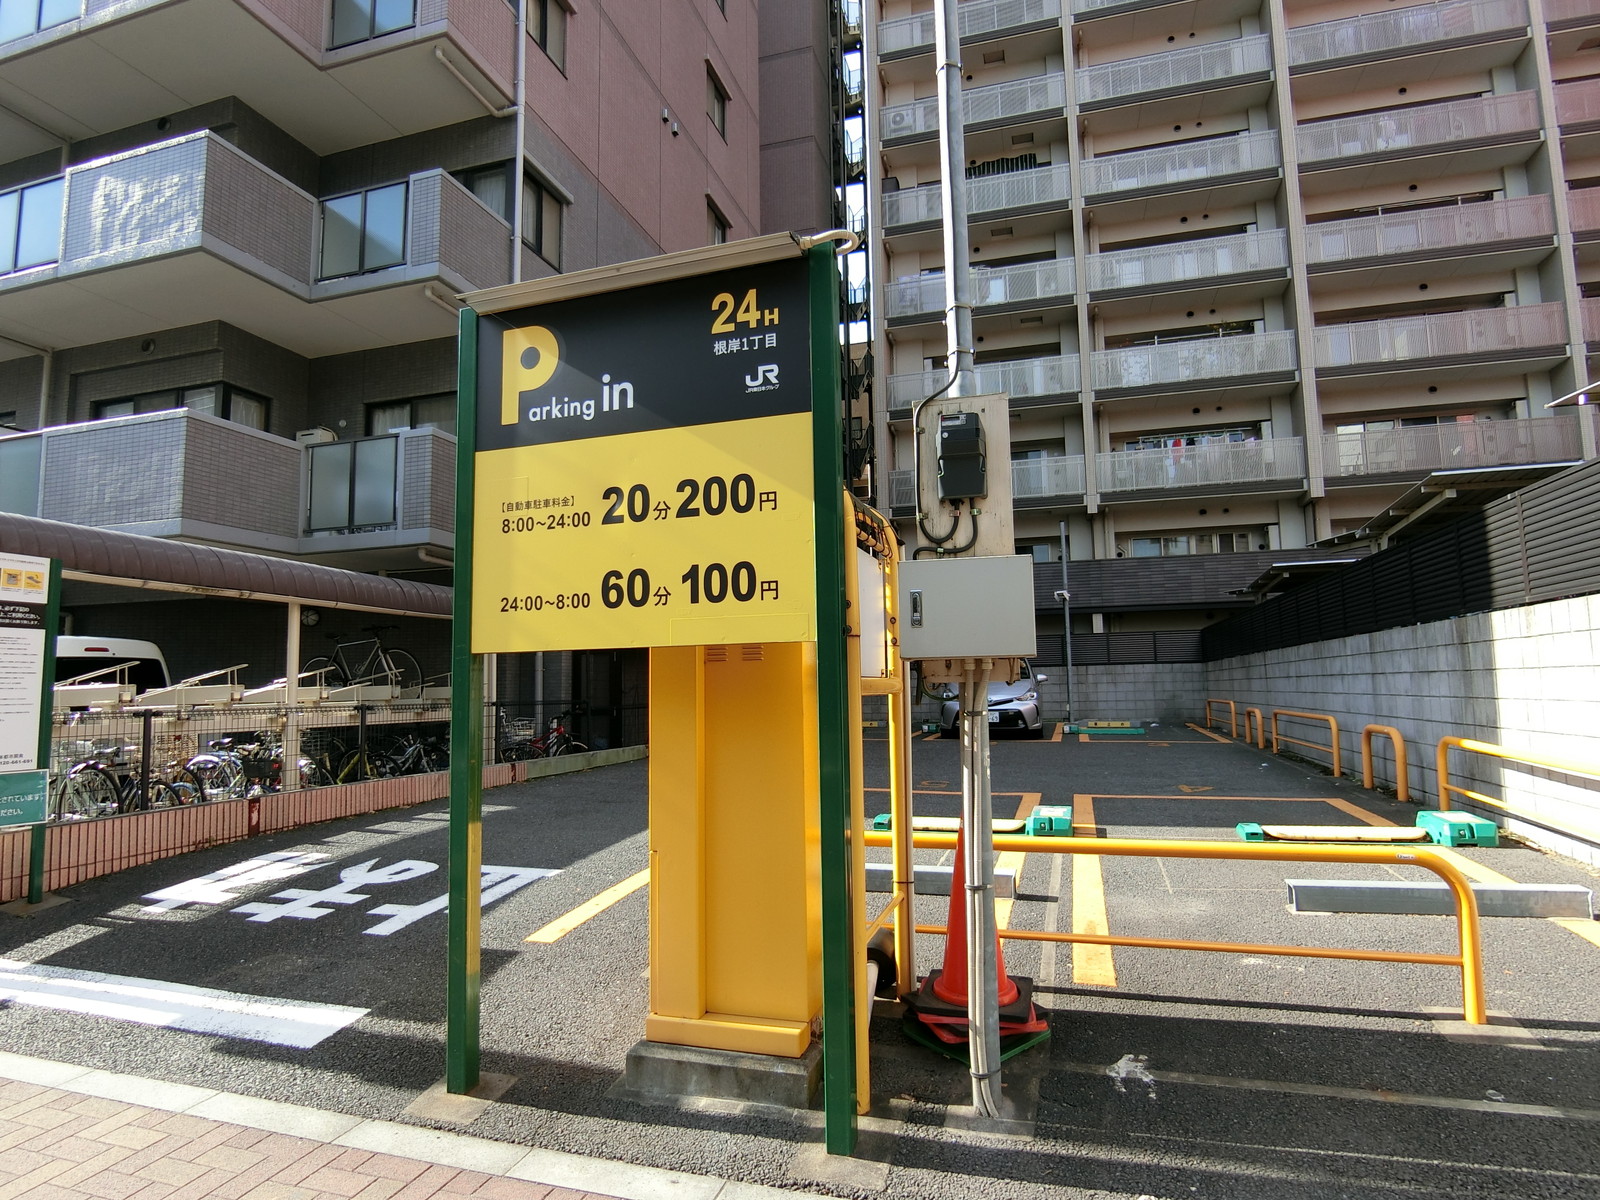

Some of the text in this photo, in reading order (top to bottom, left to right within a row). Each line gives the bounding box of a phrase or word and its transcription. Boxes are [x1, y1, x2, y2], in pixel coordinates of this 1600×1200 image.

[711, 288, 780, 335] 24H
[714, 333, 777, 356] 根岸1丁目
[501, 325, 634, 426] Parking in
[745, 363, 780, 388] JR
[502, 496, 575, 513] 【自動車駐車料金】
